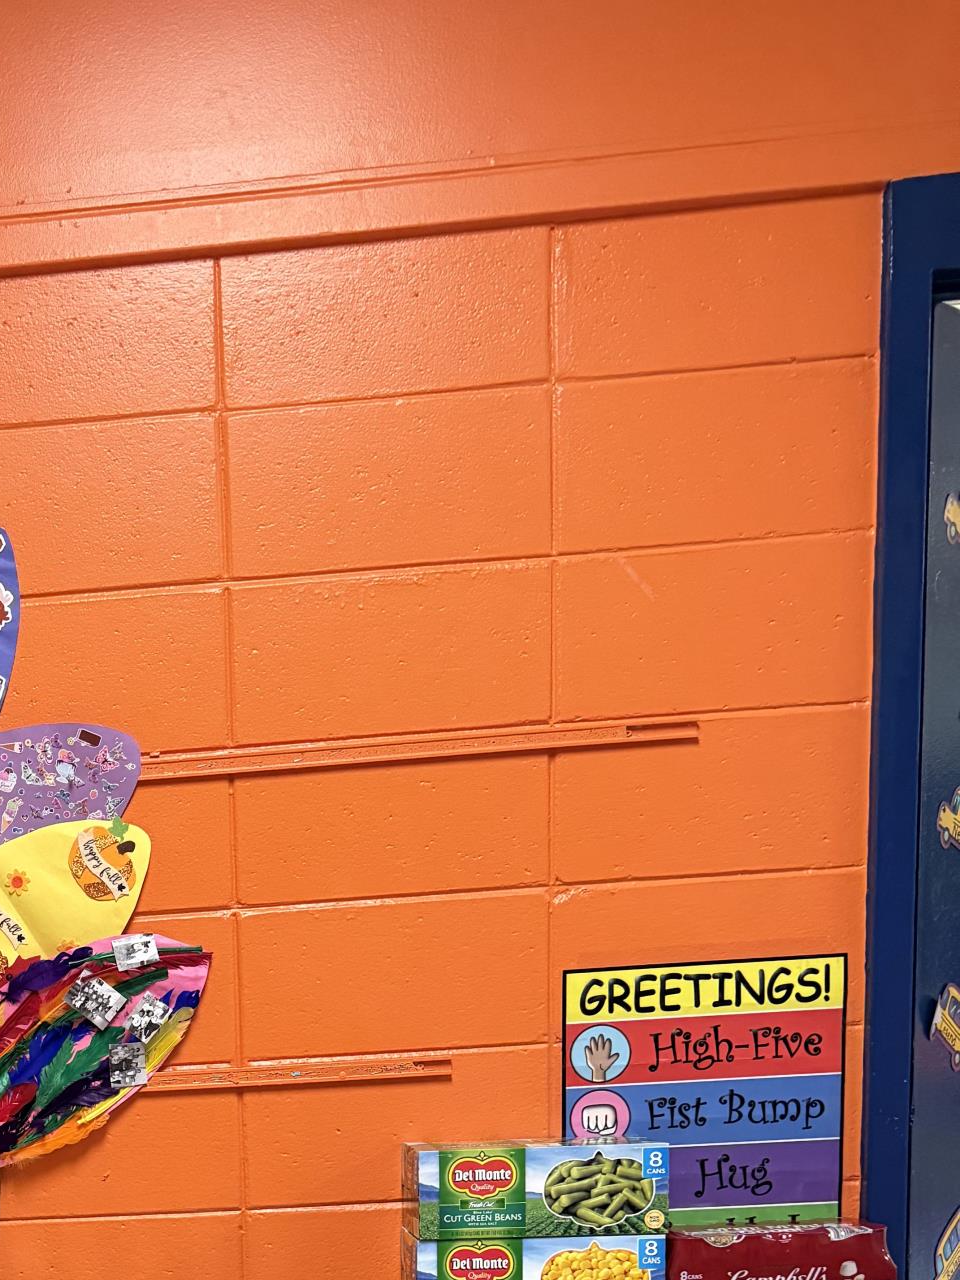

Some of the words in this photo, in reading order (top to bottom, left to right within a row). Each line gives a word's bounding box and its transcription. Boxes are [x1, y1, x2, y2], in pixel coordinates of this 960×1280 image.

[82, 838, 102, 869] happy
[98, 866, 122, 887] fall
[0, 917, 22, 936] fall
[579, 963, 831, 1016] GREETINGS!
[648, 1024, 823, 1073] High-Five
[645, 1096, 707, 1131] Fist
[719, 1089, 825, 1131] Bump
[649, 1151, 663, 1167] 8
[454, 1169, 473, 1182] Del
[474, 1168, 512, 1181] Monte
[693, 1153, 773, 1198] Hug
[470, 1183, 494, 1192] Quality
[443, 1214, 463, 1223] CUT
[464, 1213, 492, 1222] GREEN
[494, 1213, 522, 1221] BEANS
[645, 1240, 659, 1256] 8
[451, 1257, 471, 1270] Del
[472, 1257, 509, 1270] Monte
[642, 1256, 661, 1264] CANS
[468, 1272, 492, 1280] Quality
